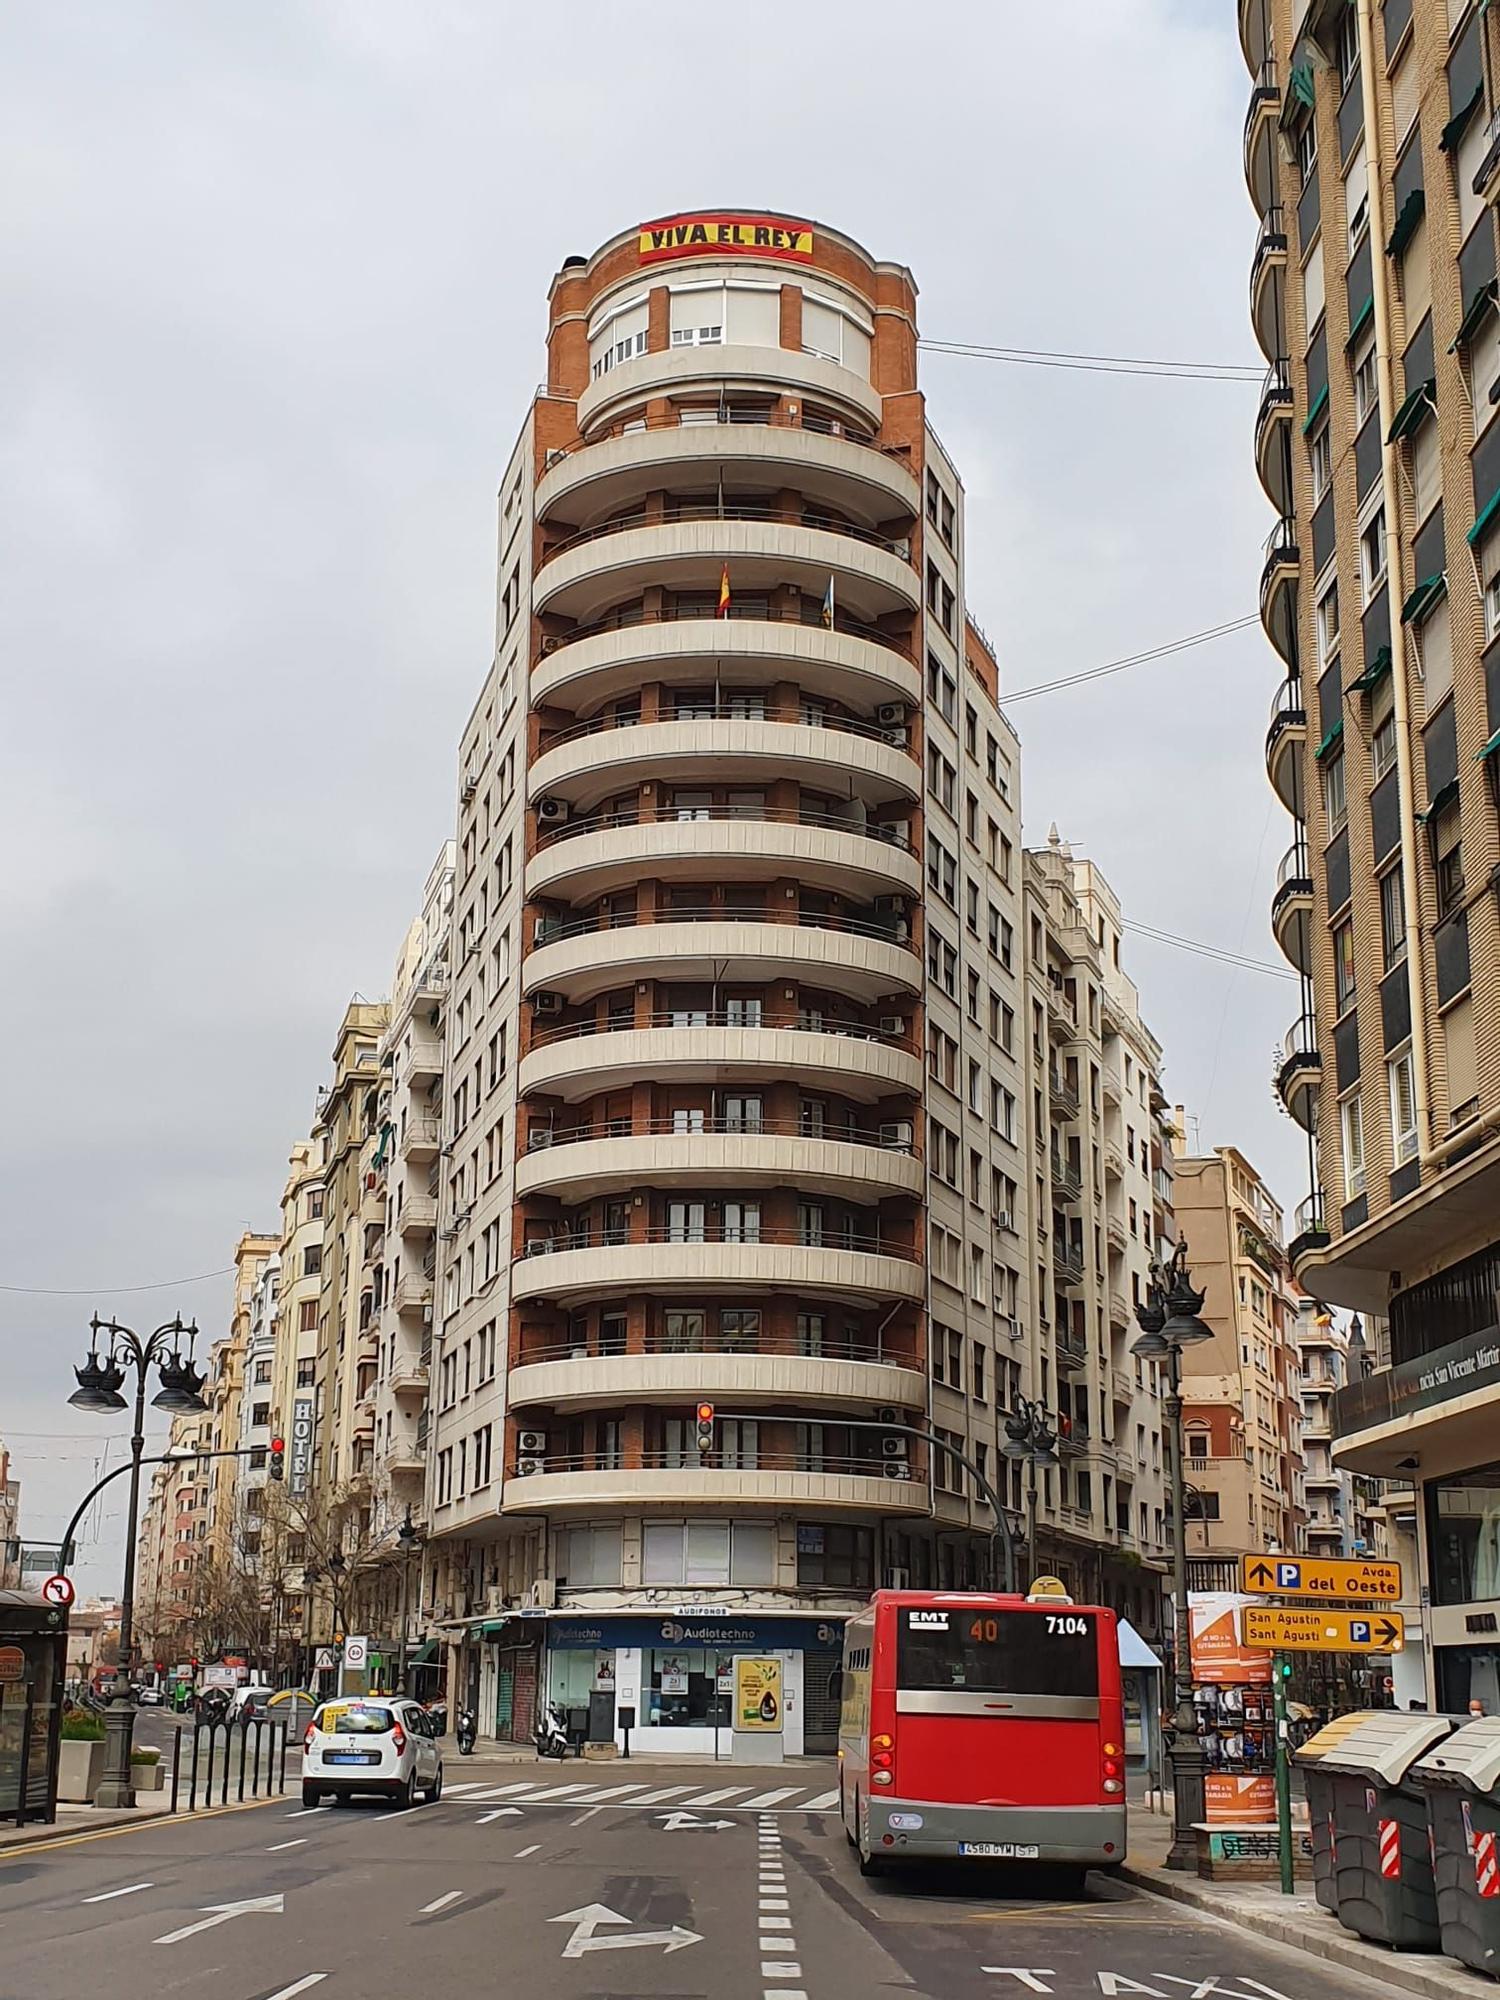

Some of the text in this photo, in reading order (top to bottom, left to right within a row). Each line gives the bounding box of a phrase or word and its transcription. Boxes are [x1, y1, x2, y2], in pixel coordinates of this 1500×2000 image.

[651, 224, 801, 249] VIVA EL REY
[1435, 1366, 1448, 1386] San
[1447, 1357, 1476, 1380] Vicente
[293, 1403, 311, 1493] HOTEL
[1281, 1565, 1396, 1594] P del Oeste
[1362, 1566, 1396, 1577] Avda.
[909, 1612, 949, 1622] EMT
[1045, 1616, 1087, 1635] 7104
[1249, 1612, 1271, 1623] San
[684, 1627, 756, 1639] Audiotechno
[970, 1619, 998, 1642] 40
[1250, 1629, 1276, 1639] Sant
[1352, 1622, 1366, 1640] P
[966, 1844, 990, 1854] 4580
[1018, 1846, 1036, 1857] SP
[980, 1966, 1293, 2000] TAXI
